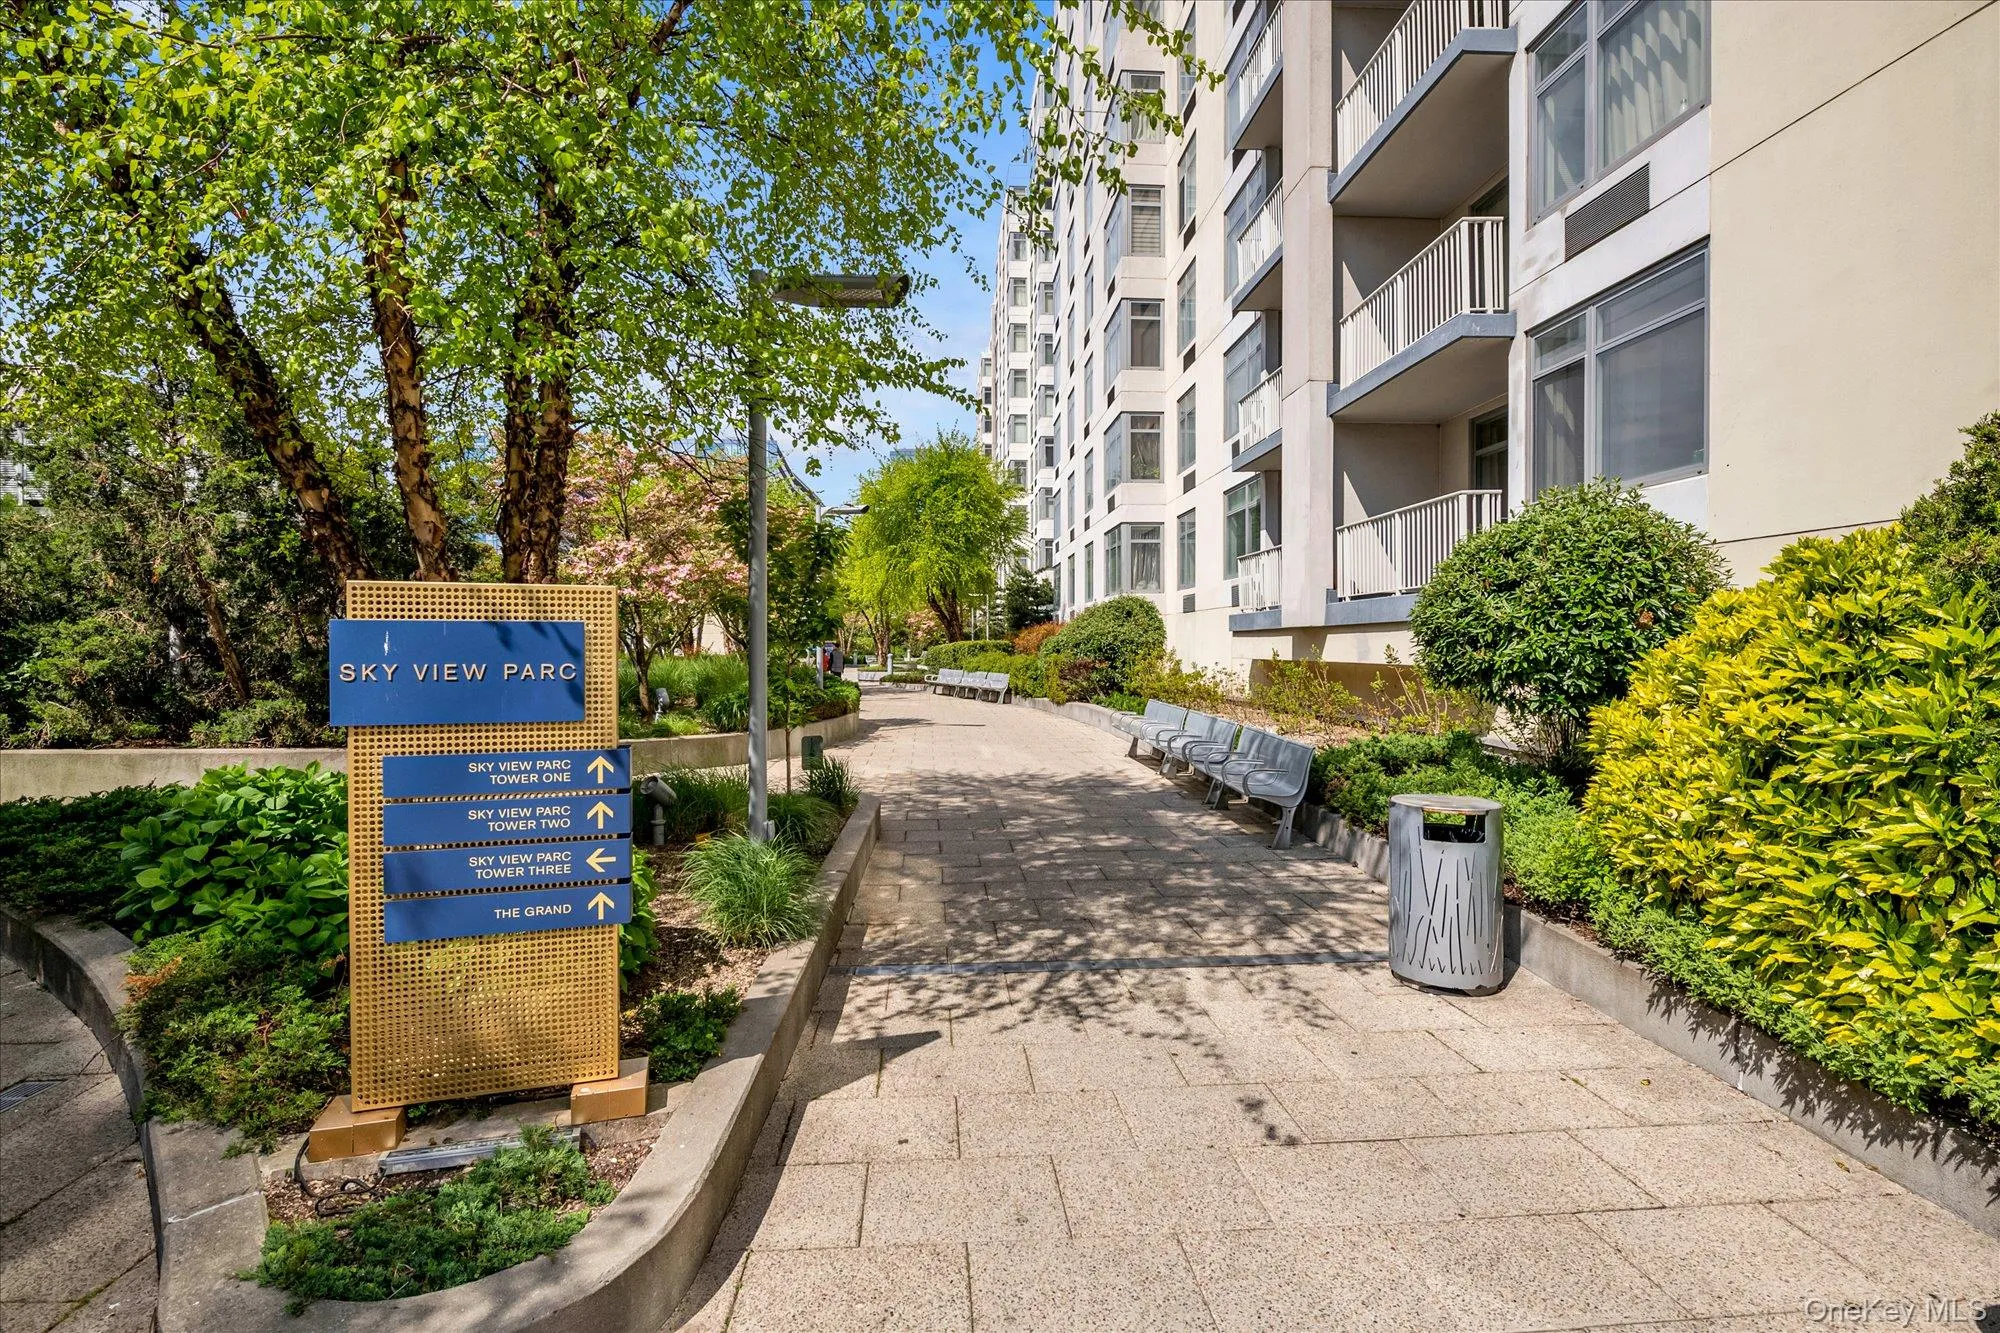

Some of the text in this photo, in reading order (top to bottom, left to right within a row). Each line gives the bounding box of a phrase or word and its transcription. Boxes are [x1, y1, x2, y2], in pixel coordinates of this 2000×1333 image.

[339, 662, 577, 682] SKY VIEW PARC
[468, 759, 571, 773] SKY VIEW PARC
[490, 771, 571, 785] TOWER ONE
[468, 805, 571, 821] SKY VIEW PARC
[488, 818, 571, 832] TOWER TWO
[468, 851, 571, 867] SKY VIEW PARC
[475, 864, 571, 879] TOWER THREE
[494, 904, 571, 919] THE GRAND
